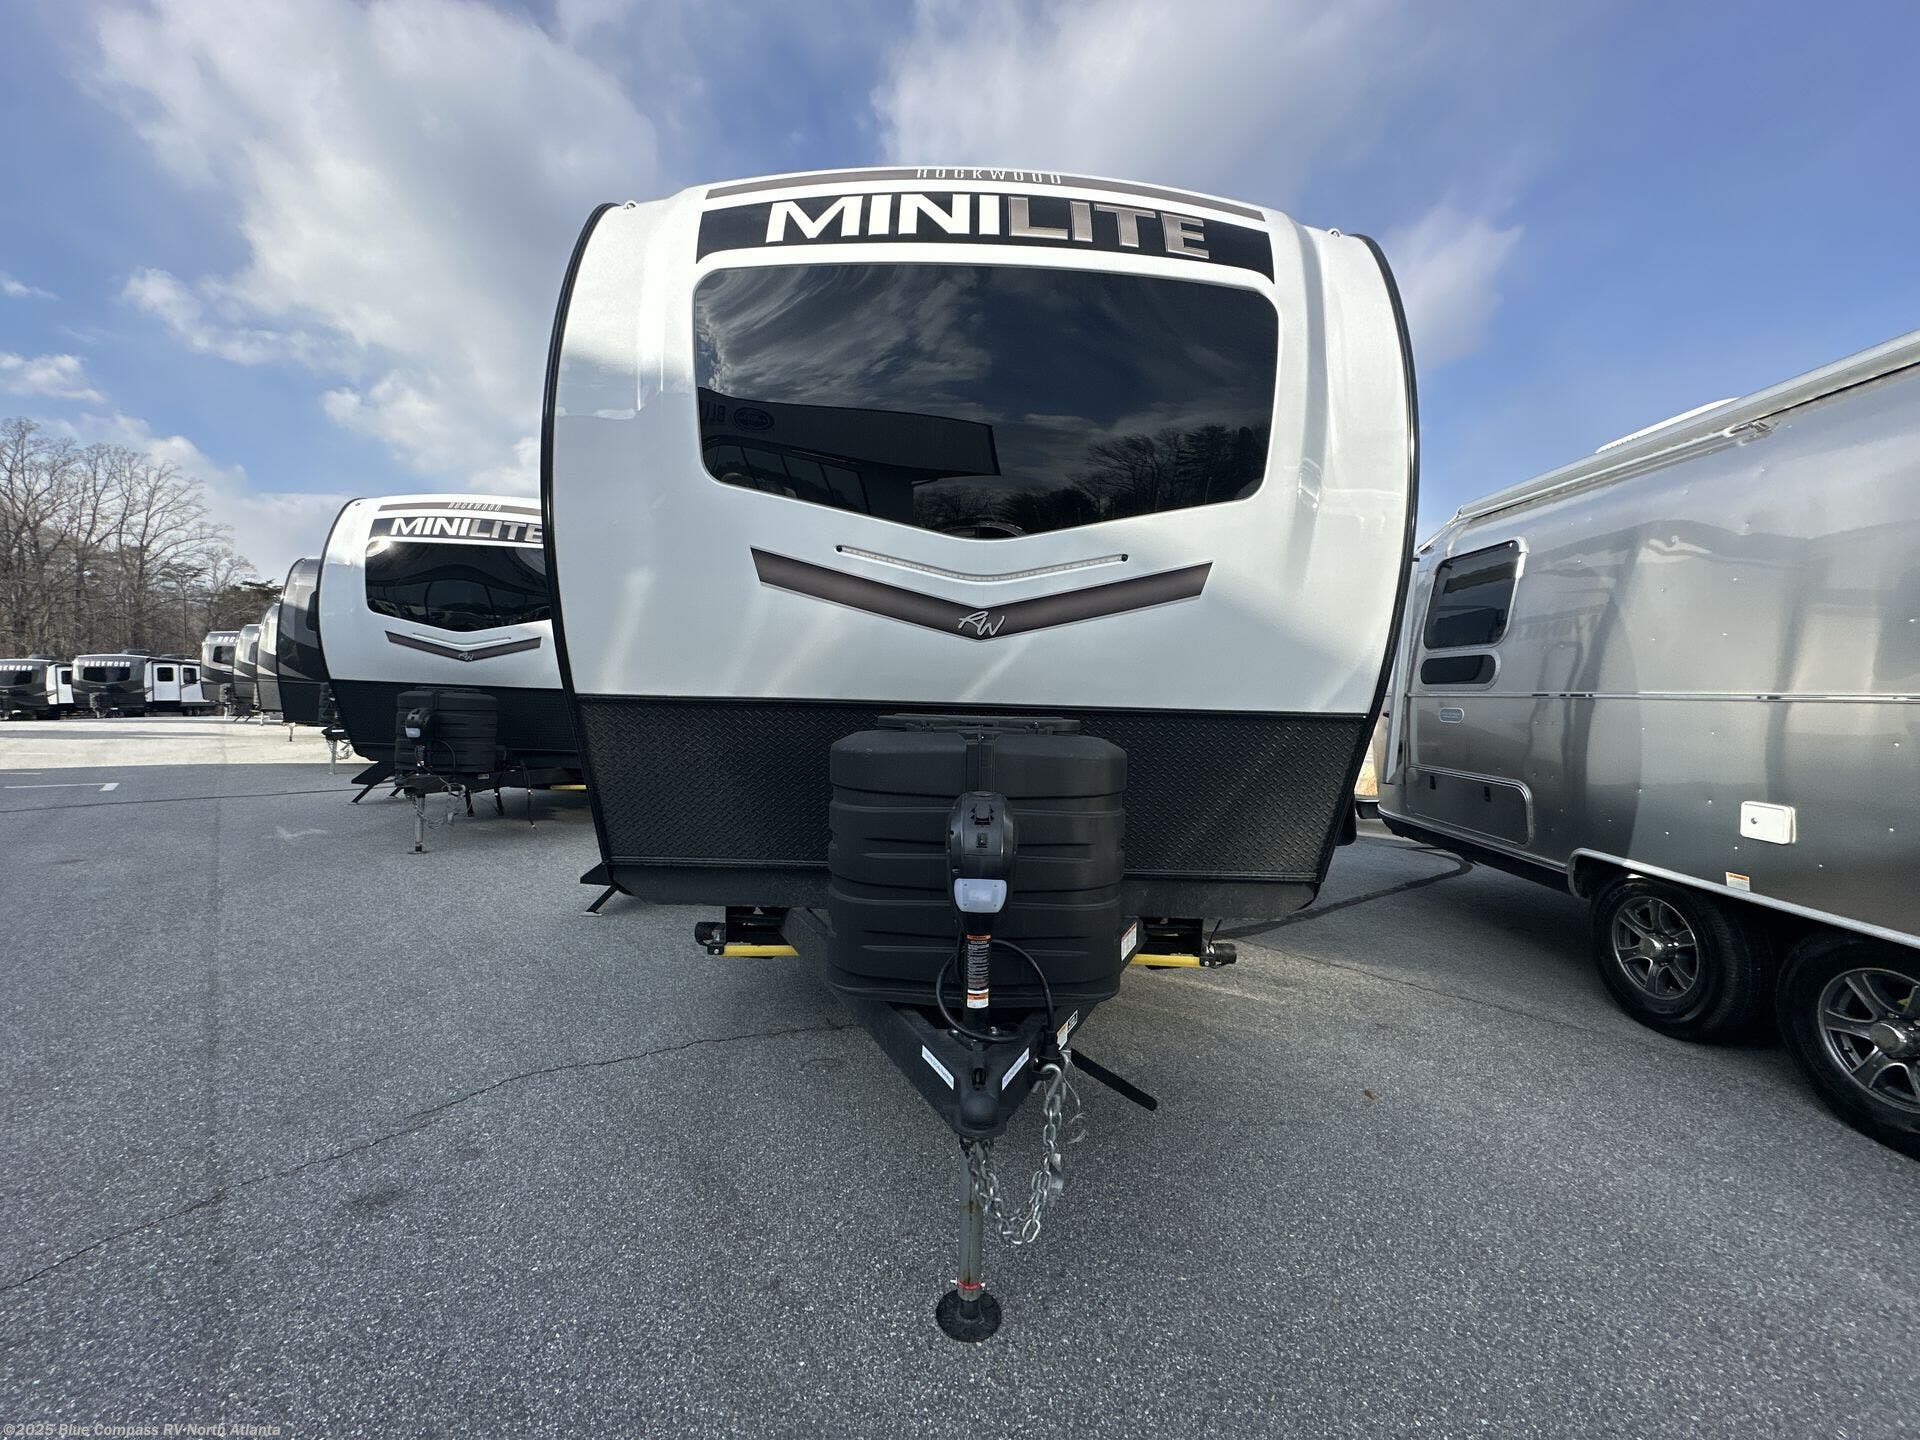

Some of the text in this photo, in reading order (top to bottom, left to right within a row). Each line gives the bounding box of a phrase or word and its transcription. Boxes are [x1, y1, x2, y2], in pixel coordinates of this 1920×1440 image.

[916, 168, 1061, 184] ROCKWOOD
[765, 193, 1210, 258] MINILITE
[390, 517, 543, 542] MINILITE
